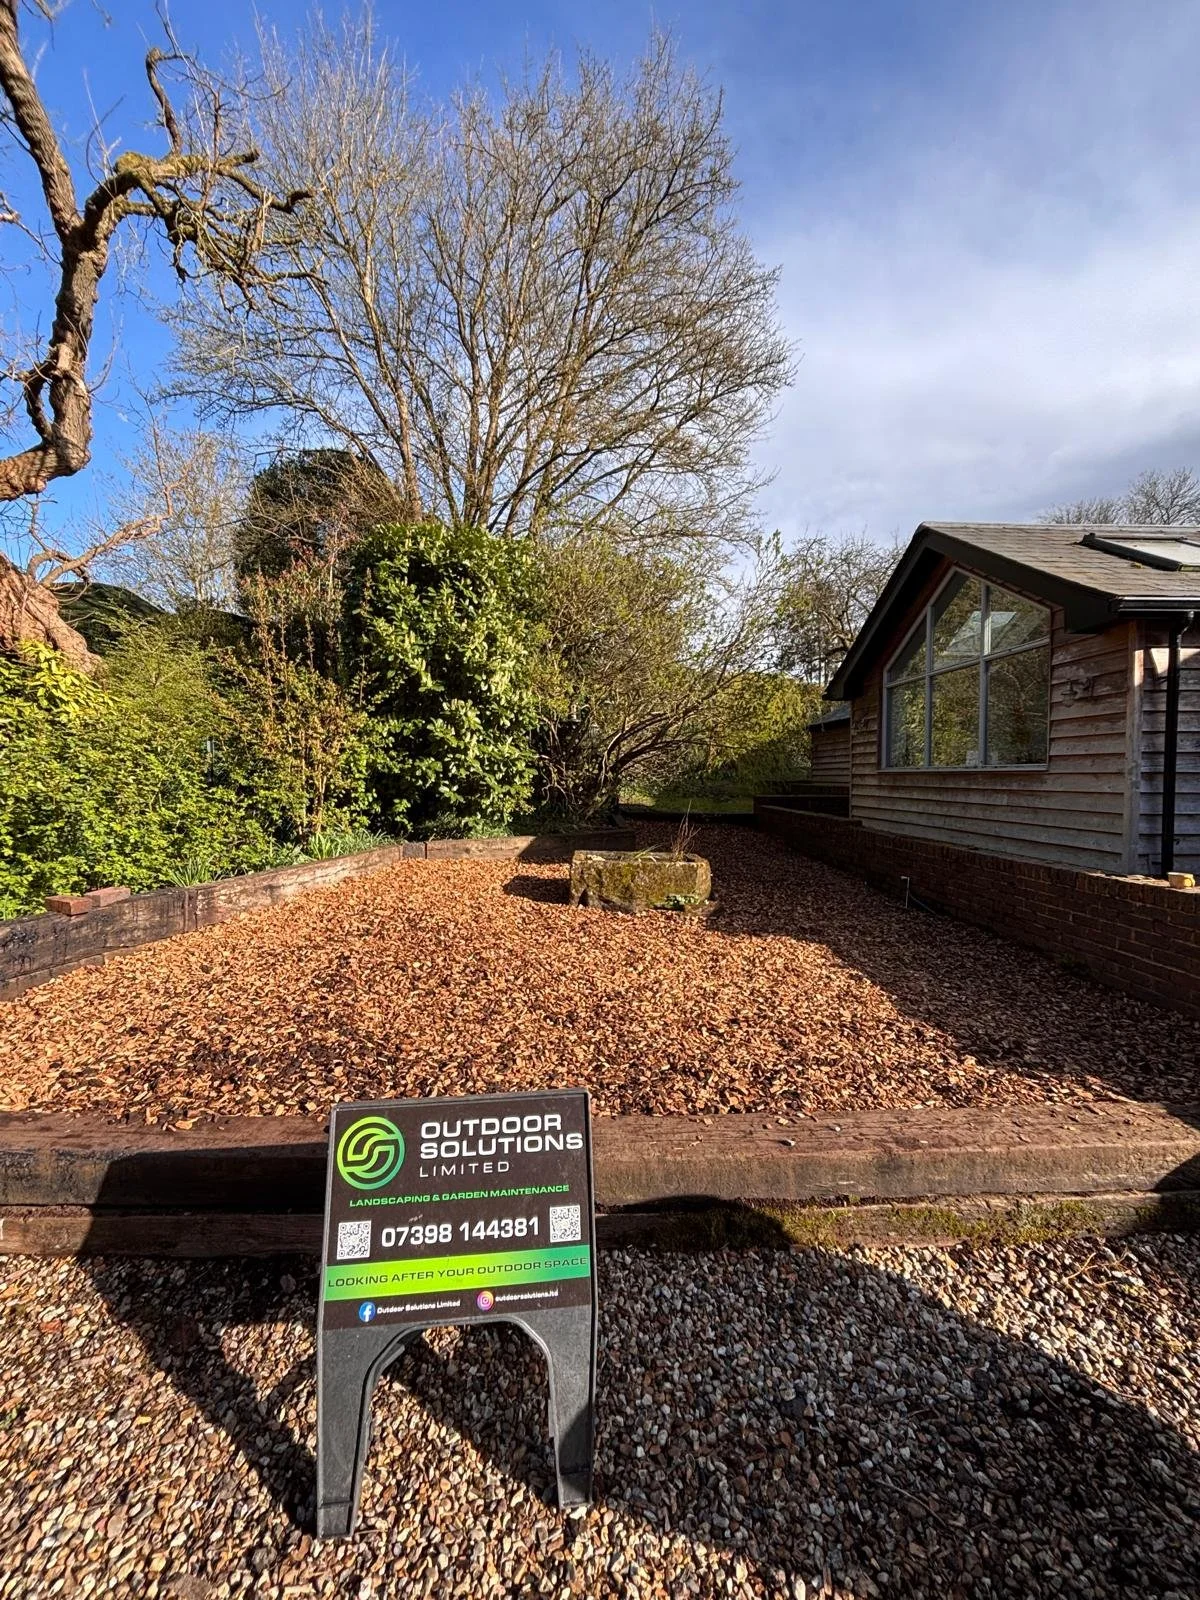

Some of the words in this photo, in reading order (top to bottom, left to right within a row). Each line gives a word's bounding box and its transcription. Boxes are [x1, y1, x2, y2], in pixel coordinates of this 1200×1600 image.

[421, 1114, 562, 1139] OUTDOOR
[420, 1133, 584, 1159] SOLUTIONS
[419, 1161, 510, 1177] LIMITED
[350, 1194, 431, 1207] LANDSCAPING
[432, 1193, 440, 1201] &
[442, 1190, 488, 1201] GARDEN
[490, 1184, 570, 1197] MAINTENANCE
[381, 1225, 452, 1248] 07398
[459, 1217, 539, 1241] 144381
[328, 1274, 388, 1287] LOOKING
[391, 1271, 434, 1282] AFTER
[437, 1267, 474, 1277] YOUR
[477, 1261, 541, 1274] OUTDOOR
[545, 1257, 588, 1269] SPACE
[377, 1305, 404, 1315] Outdoor
[405, 1303, 436, 1313] Solutions
[436, 1300, 461, 1310] Limited
